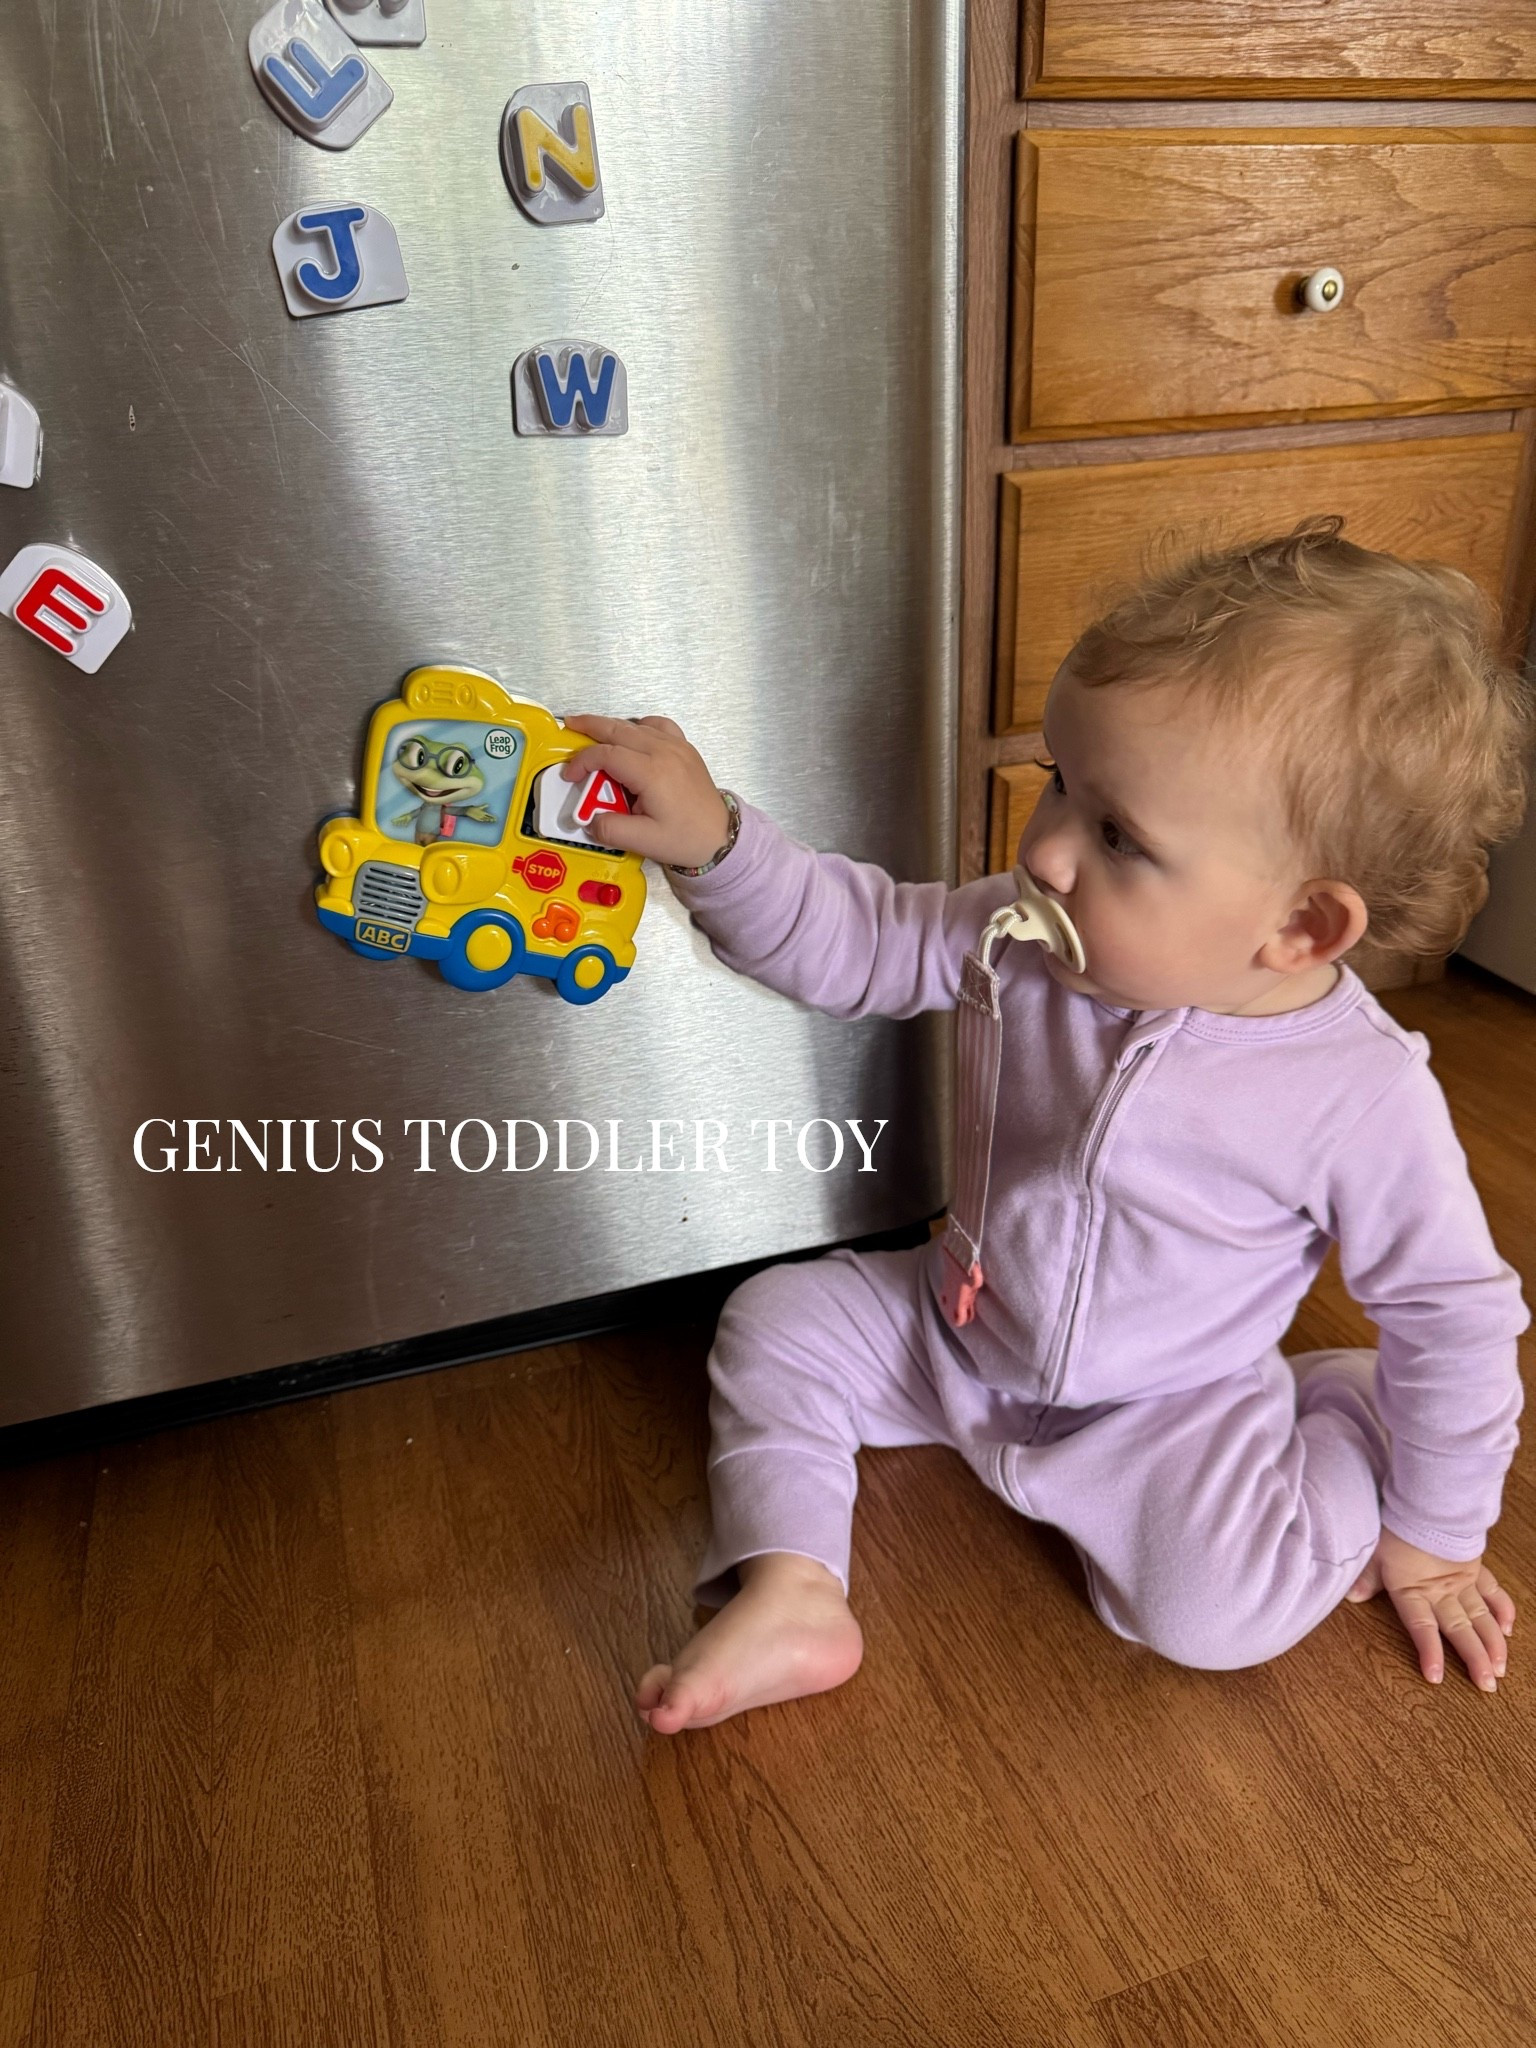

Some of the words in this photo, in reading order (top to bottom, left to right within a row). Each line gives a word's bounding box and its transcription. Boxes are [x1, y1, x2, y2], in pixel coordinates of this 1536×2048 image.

[266, 40, 365, 120] F
[297, 206, 366, 301] J
[536, 352, 617, 427] W
[15, 567, 106, 655] E
[489, 736, 510, 744] Leap
[490, 744, 511, 755] Frog
[576, 769, 630, 823] A
[527, 863, 561, 879] STOP
[361, 926, 405, 949] ABC
